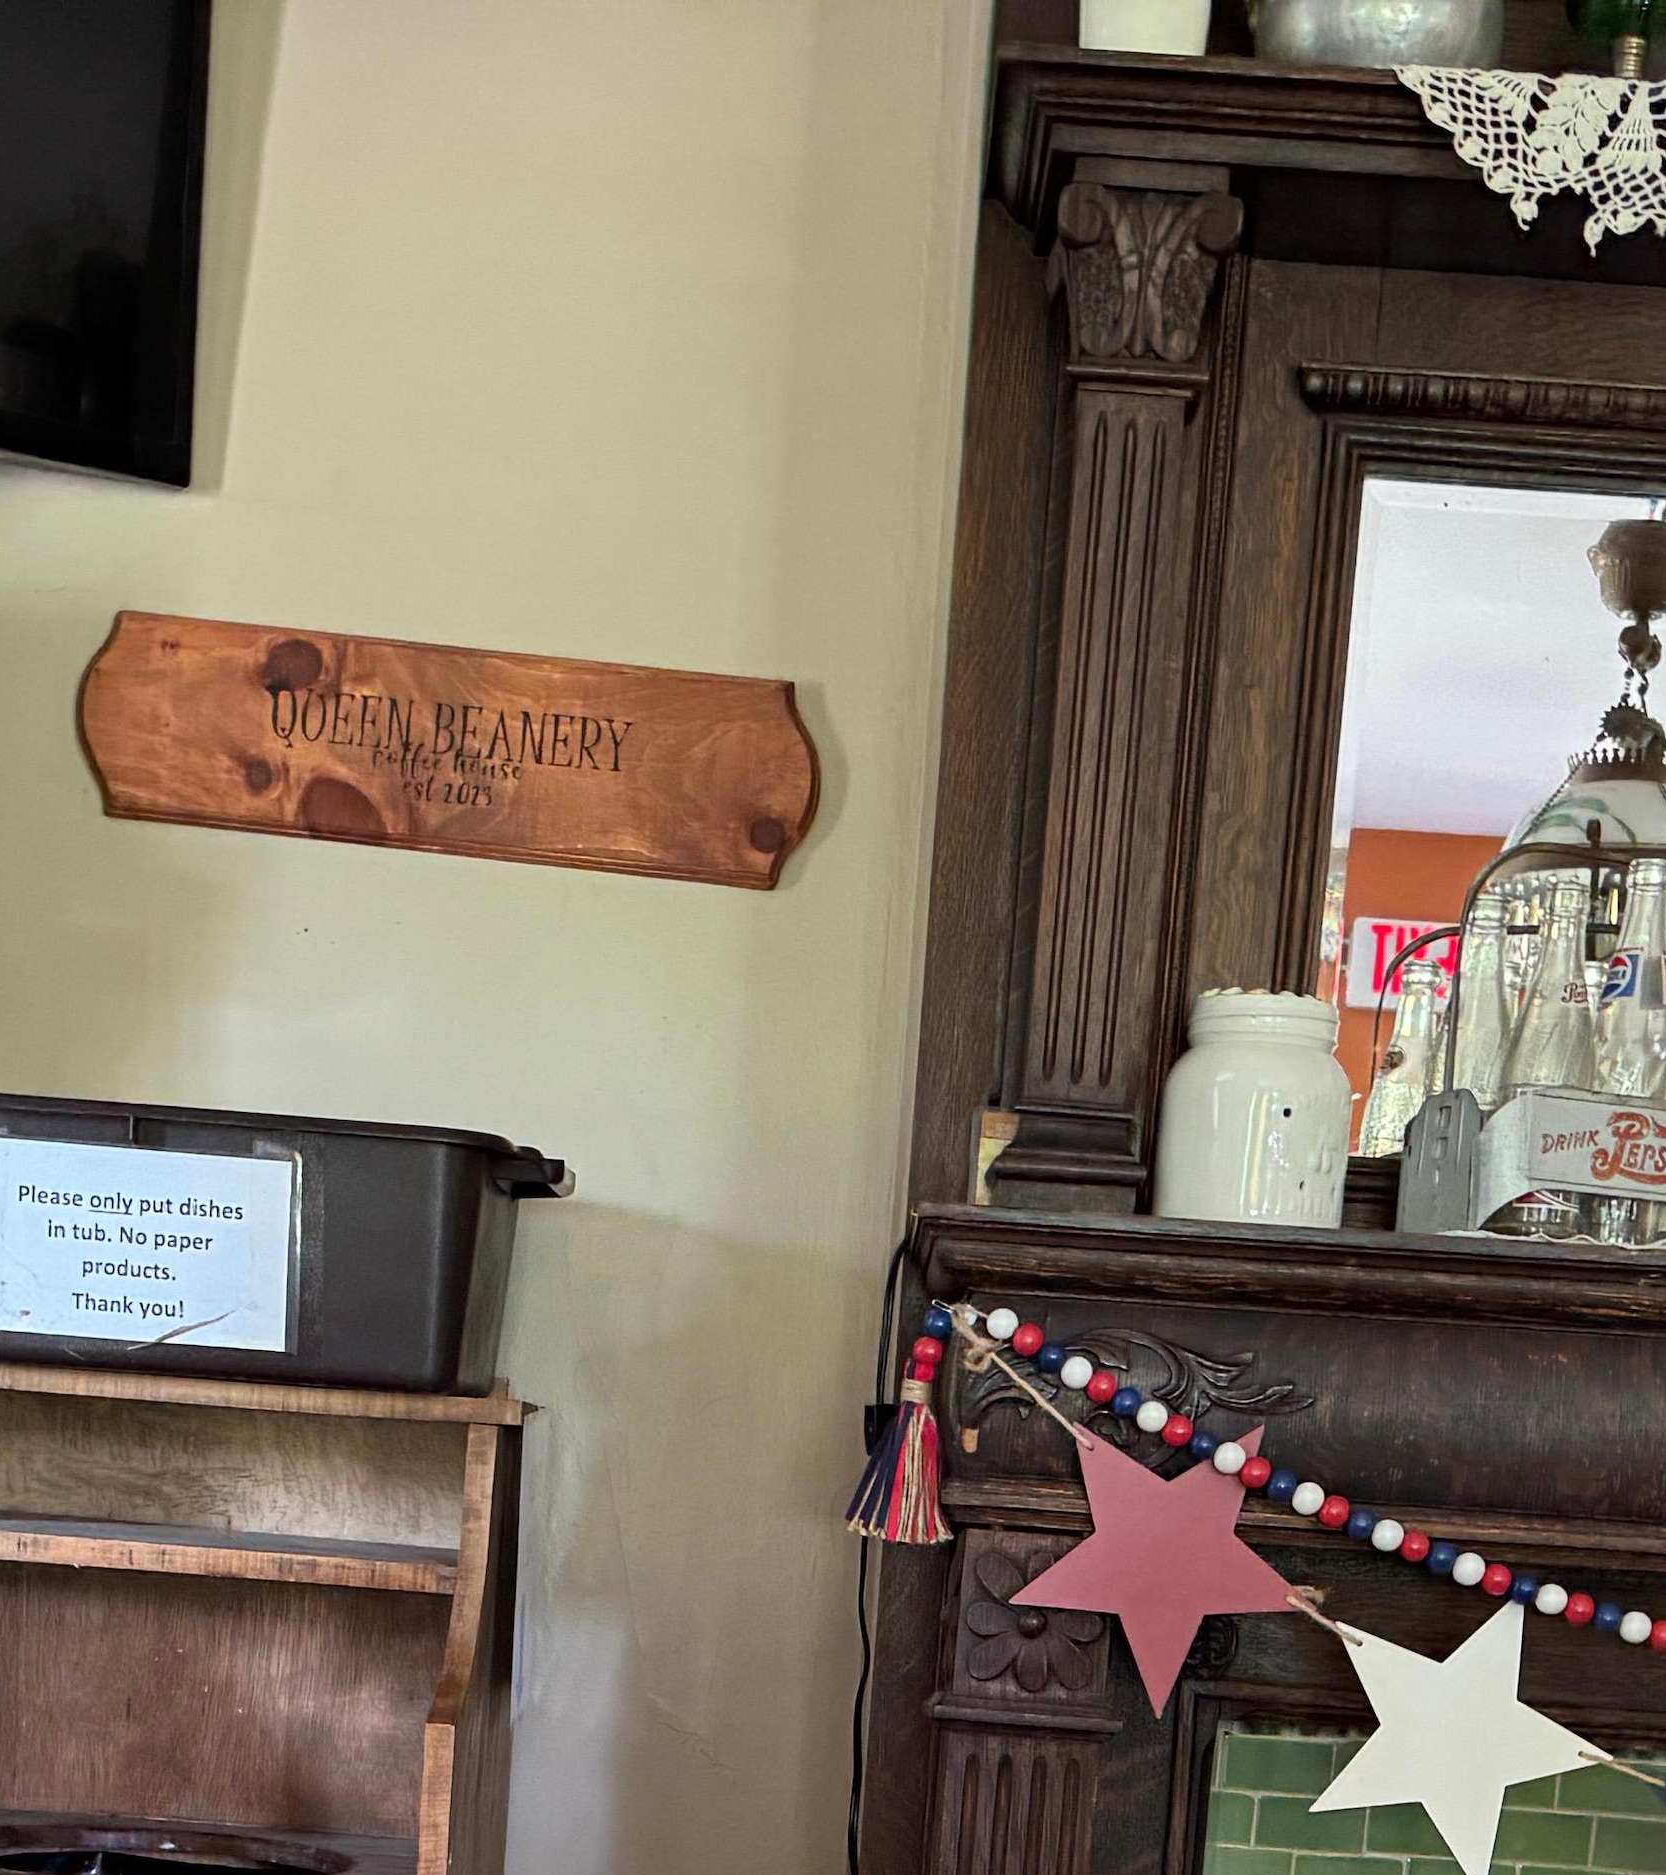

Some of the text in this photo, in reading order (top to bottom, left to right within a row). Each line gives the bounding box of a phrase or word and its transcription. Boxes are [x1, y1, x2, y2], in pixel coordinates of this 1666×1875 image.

[265, 683, 633, 772] QUEEN BEANERY
[443, 782, 493, 806] 2023
[1540, 1130, 1599, 1154] DRINK
[18, 1185, 244, 1220] Please only put dishes
[48, 1219, 214, 1252] in tub. No paper
[82, 1259, 176, 1281] products.
[72, 1292, 184, 1319] Thank you!
